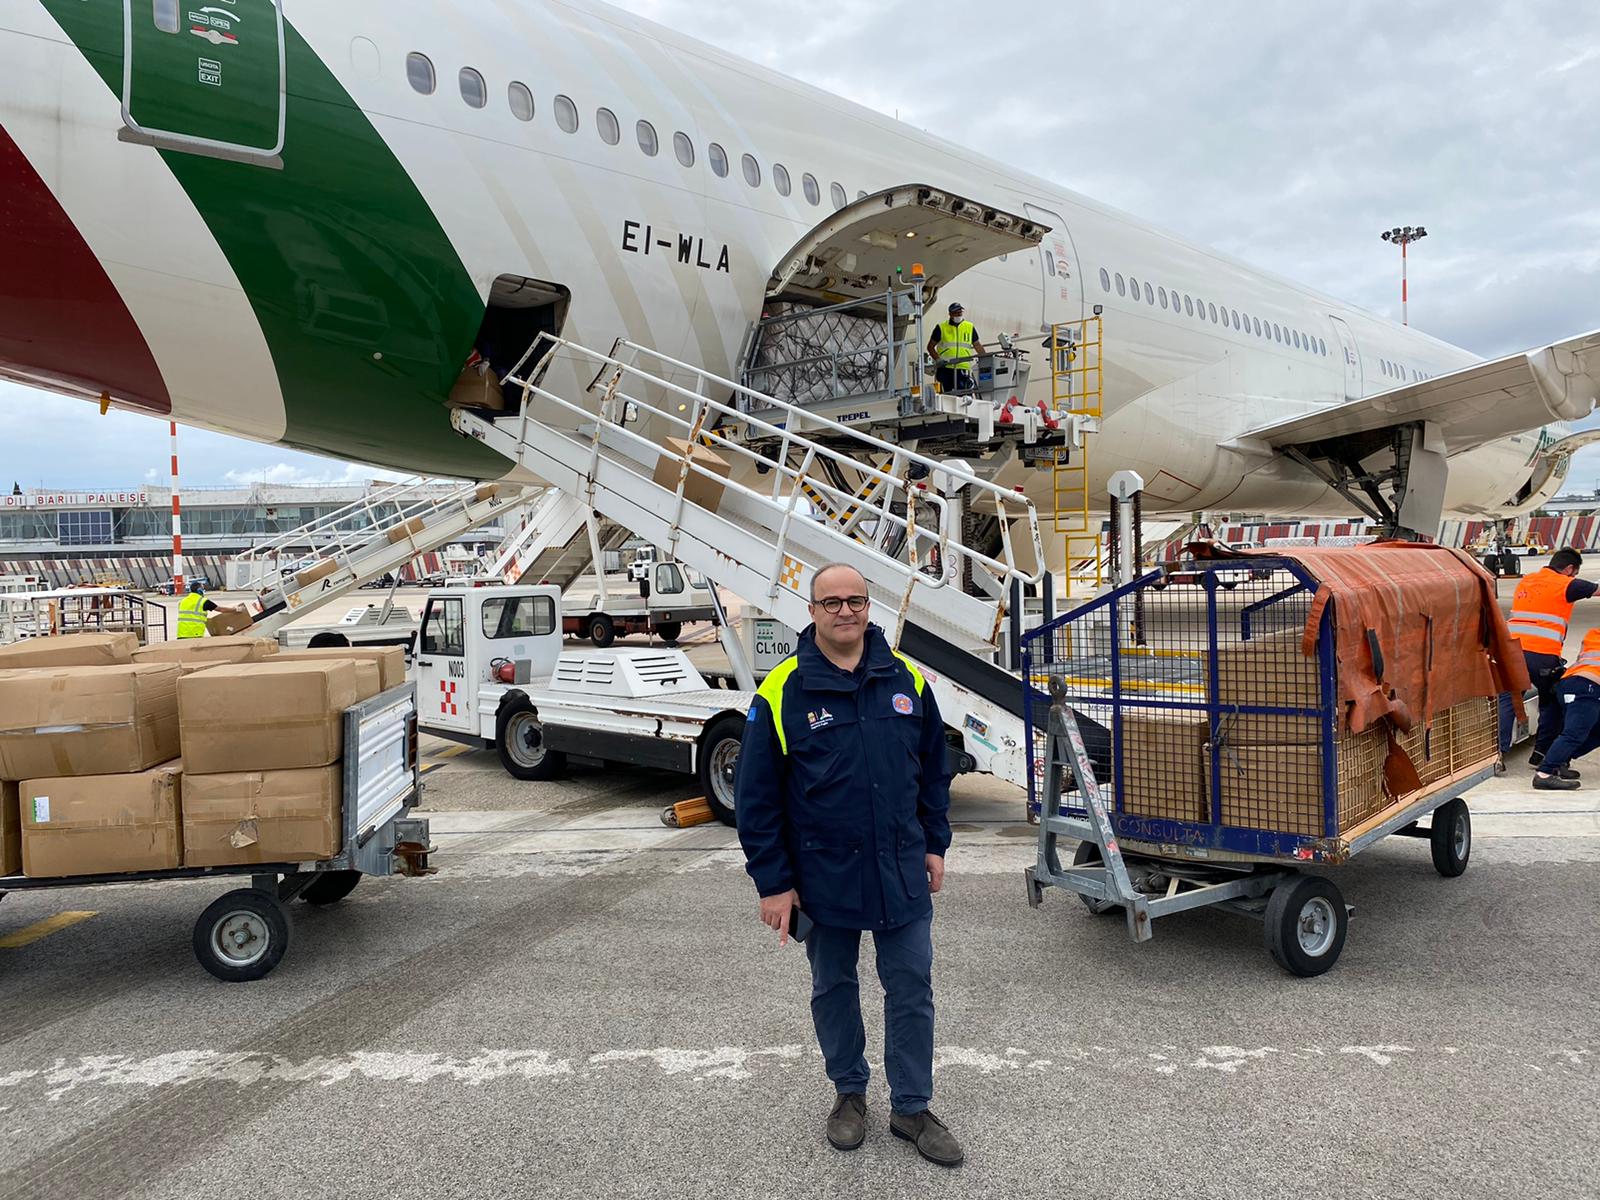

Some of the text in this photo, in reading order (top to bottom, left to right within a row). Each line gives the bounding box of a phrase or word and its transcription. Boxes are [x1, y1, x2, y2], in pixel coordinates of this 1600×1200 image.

[201, 73, 219, 82] EXIT
[622, 219, 729, 273] EI-WLA
[7, 493, 147, 505] DI BARI PALESE
[756, 642, 790, 654] CL100
[448, 660, 465, 678] N003
